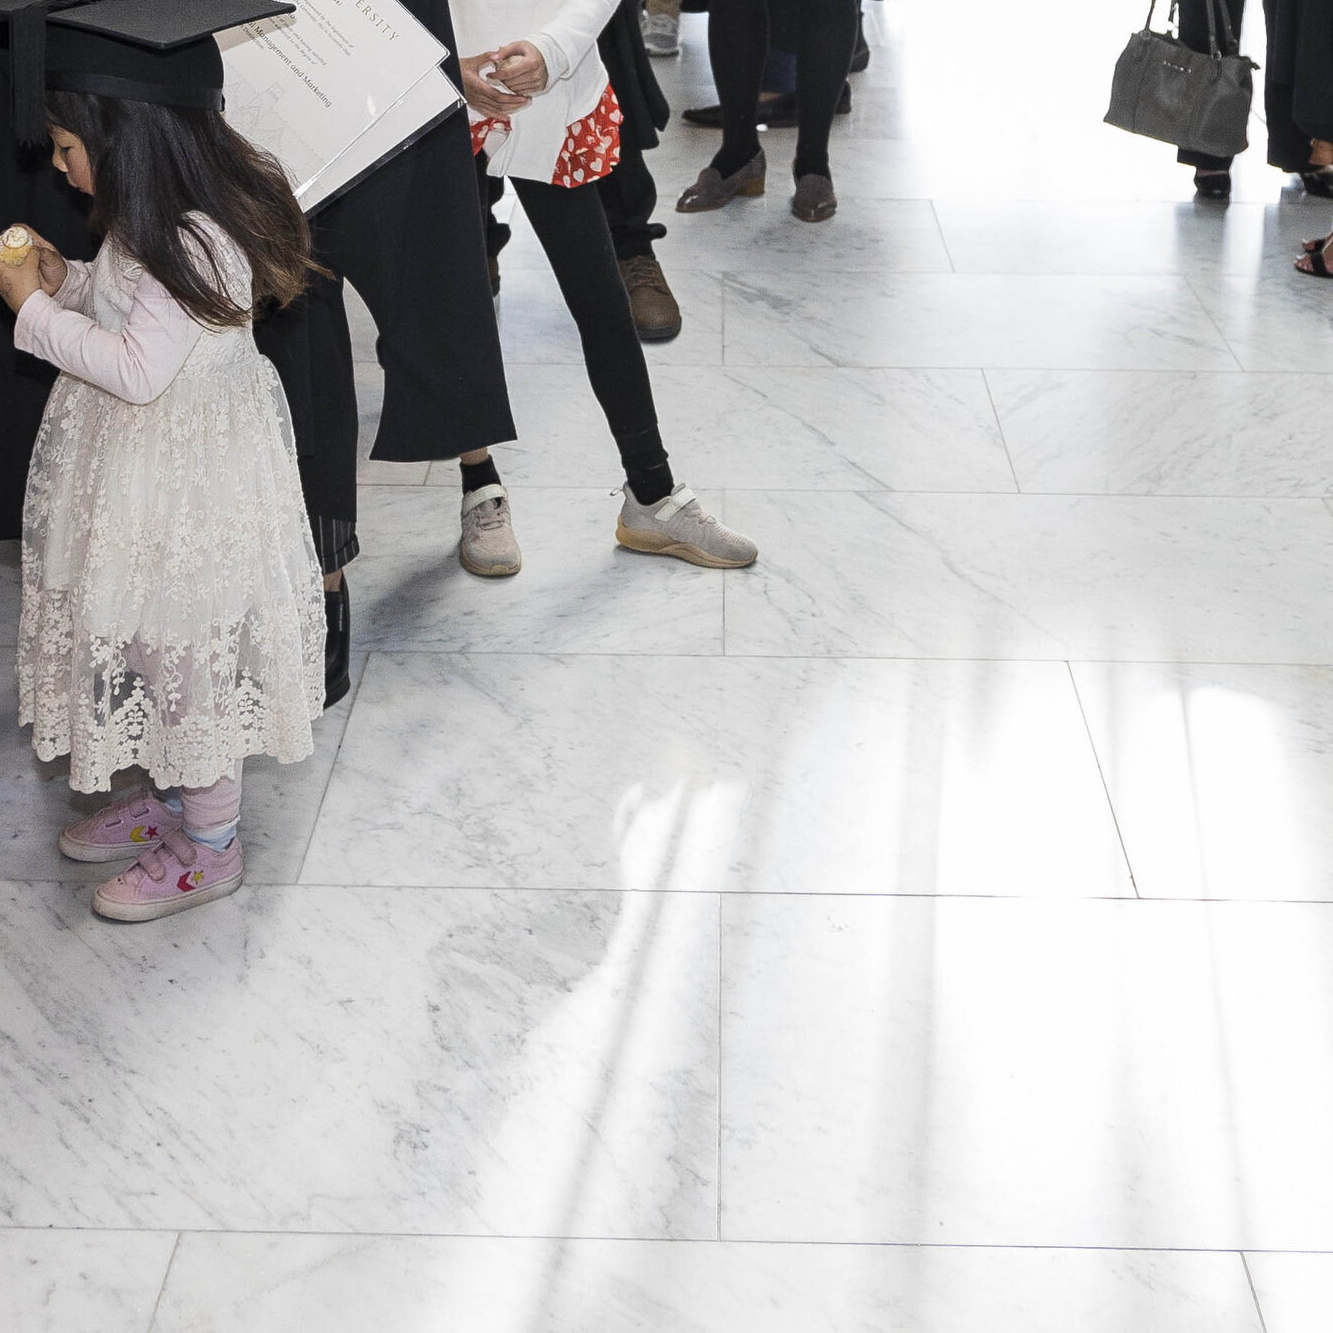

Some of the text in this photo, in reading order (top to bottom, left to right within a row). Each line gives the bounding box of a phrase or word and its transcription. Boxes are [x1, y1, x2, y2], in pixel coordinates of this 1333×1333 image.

[252, 25, 292, 67] Management
[289, 62, 305, 78] and
[300, 74, 333, 109] Marketing
